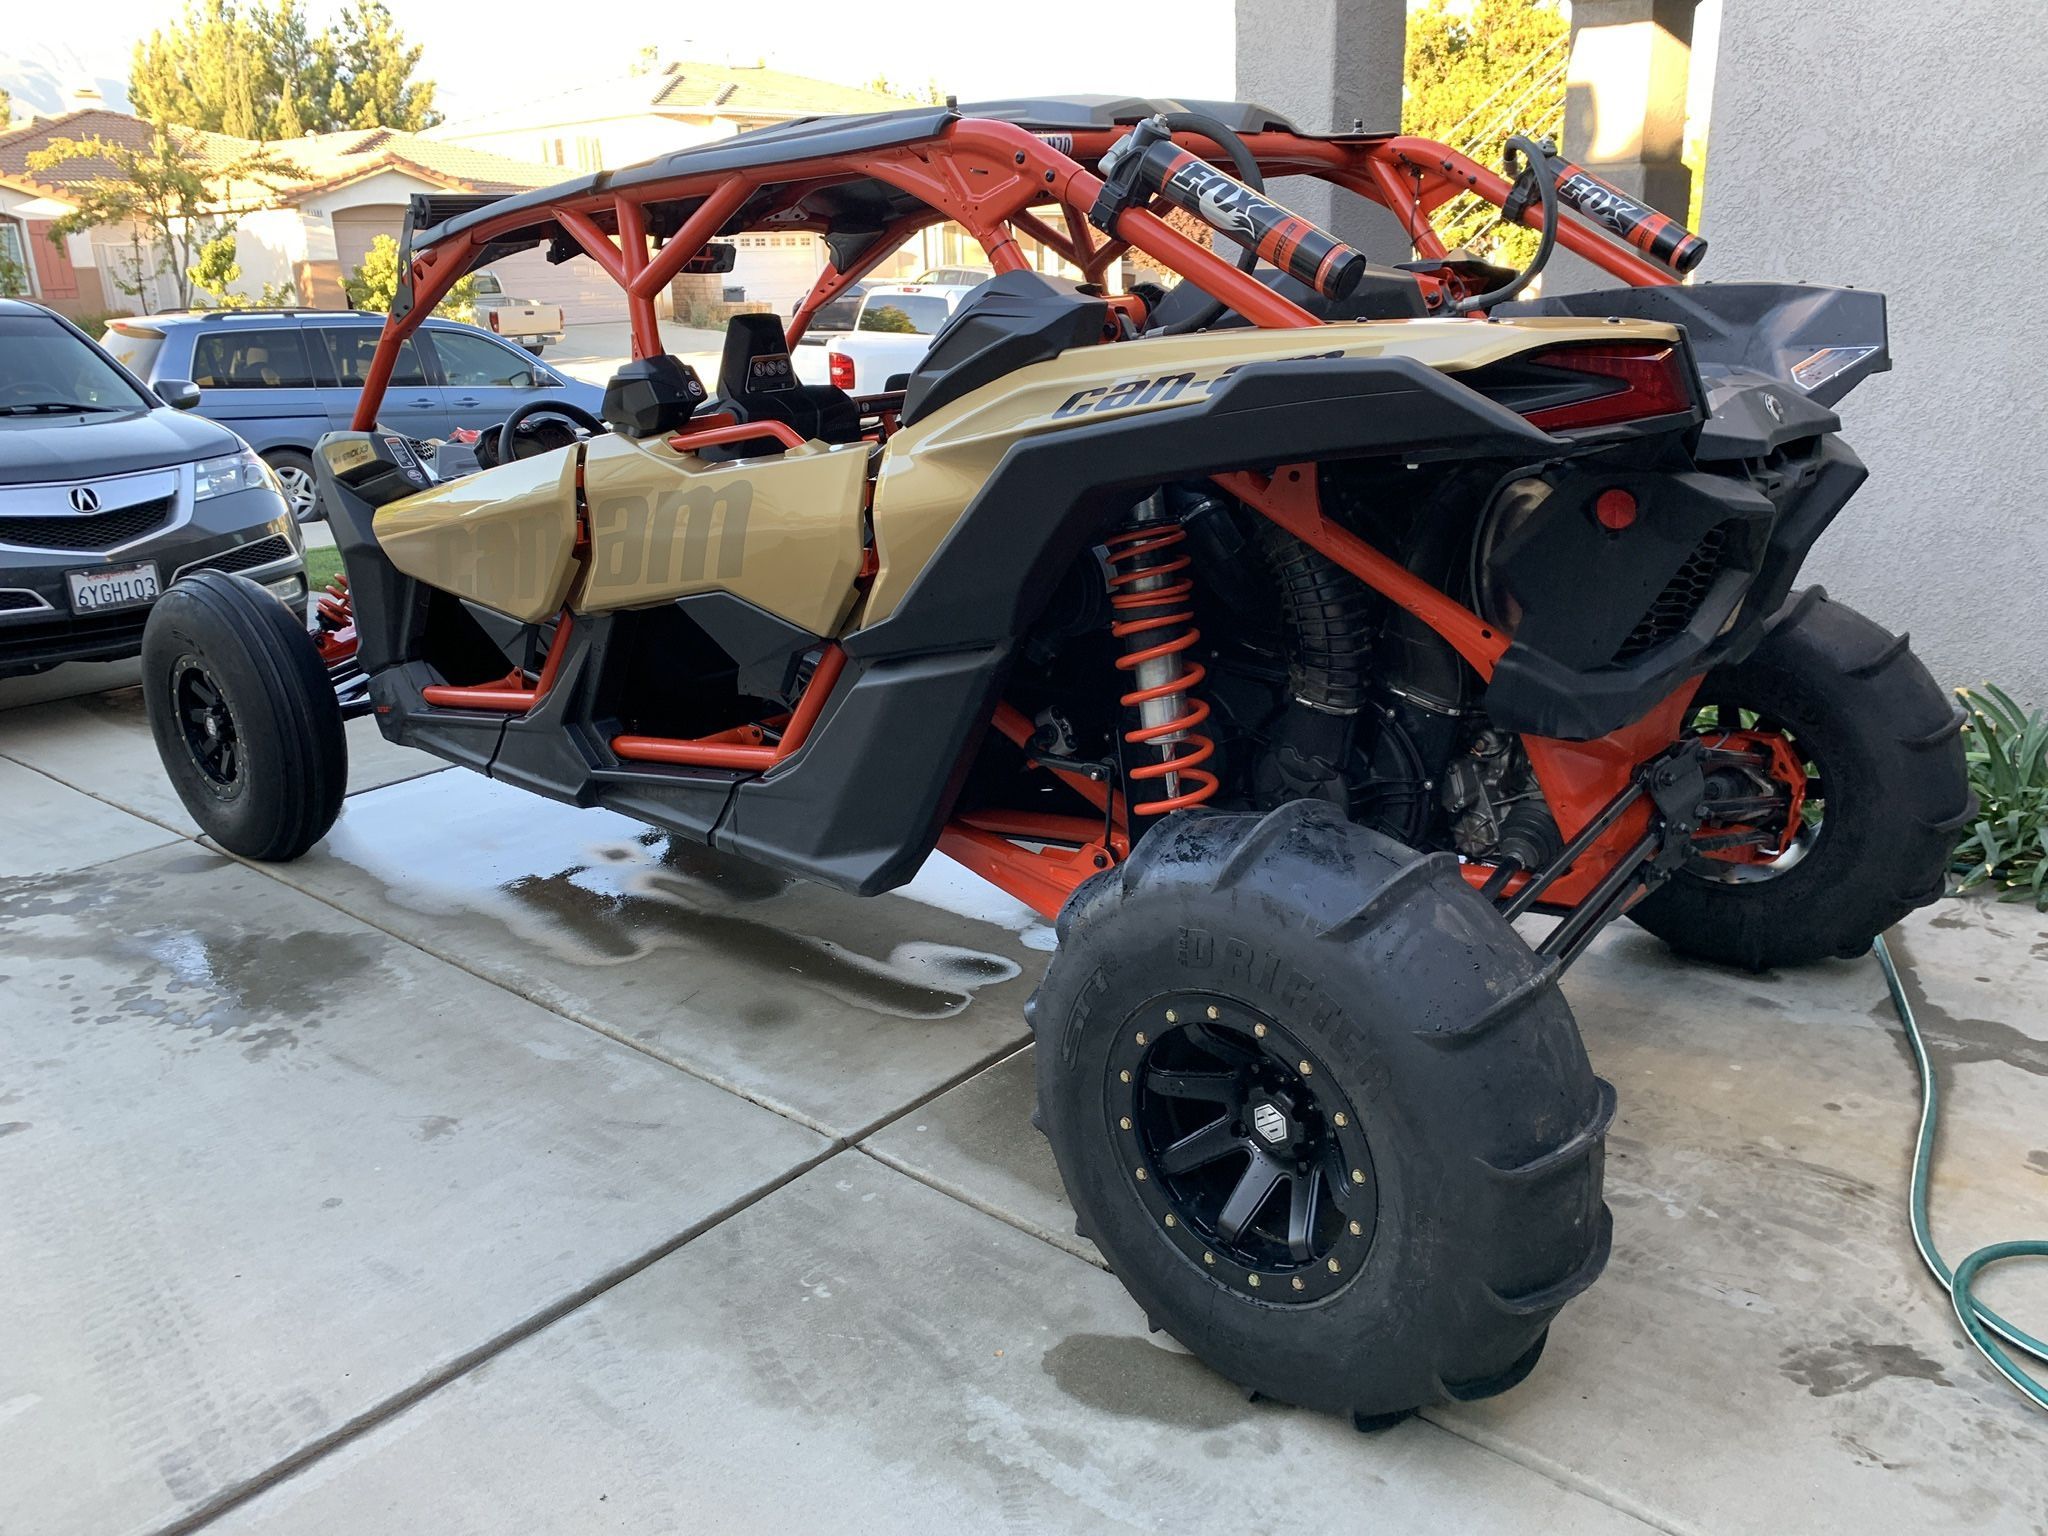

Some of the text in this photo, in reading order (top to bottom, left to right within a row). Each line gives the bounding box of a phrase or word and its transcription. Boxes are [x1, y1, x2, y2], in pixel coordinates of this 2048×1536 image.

[1171, 161, 1278, 239] FOX
[1558, 174, 1638, 235] FOX
[593, 479, 754, 588] am
[78, 577, 157, 606] 6YGH103
